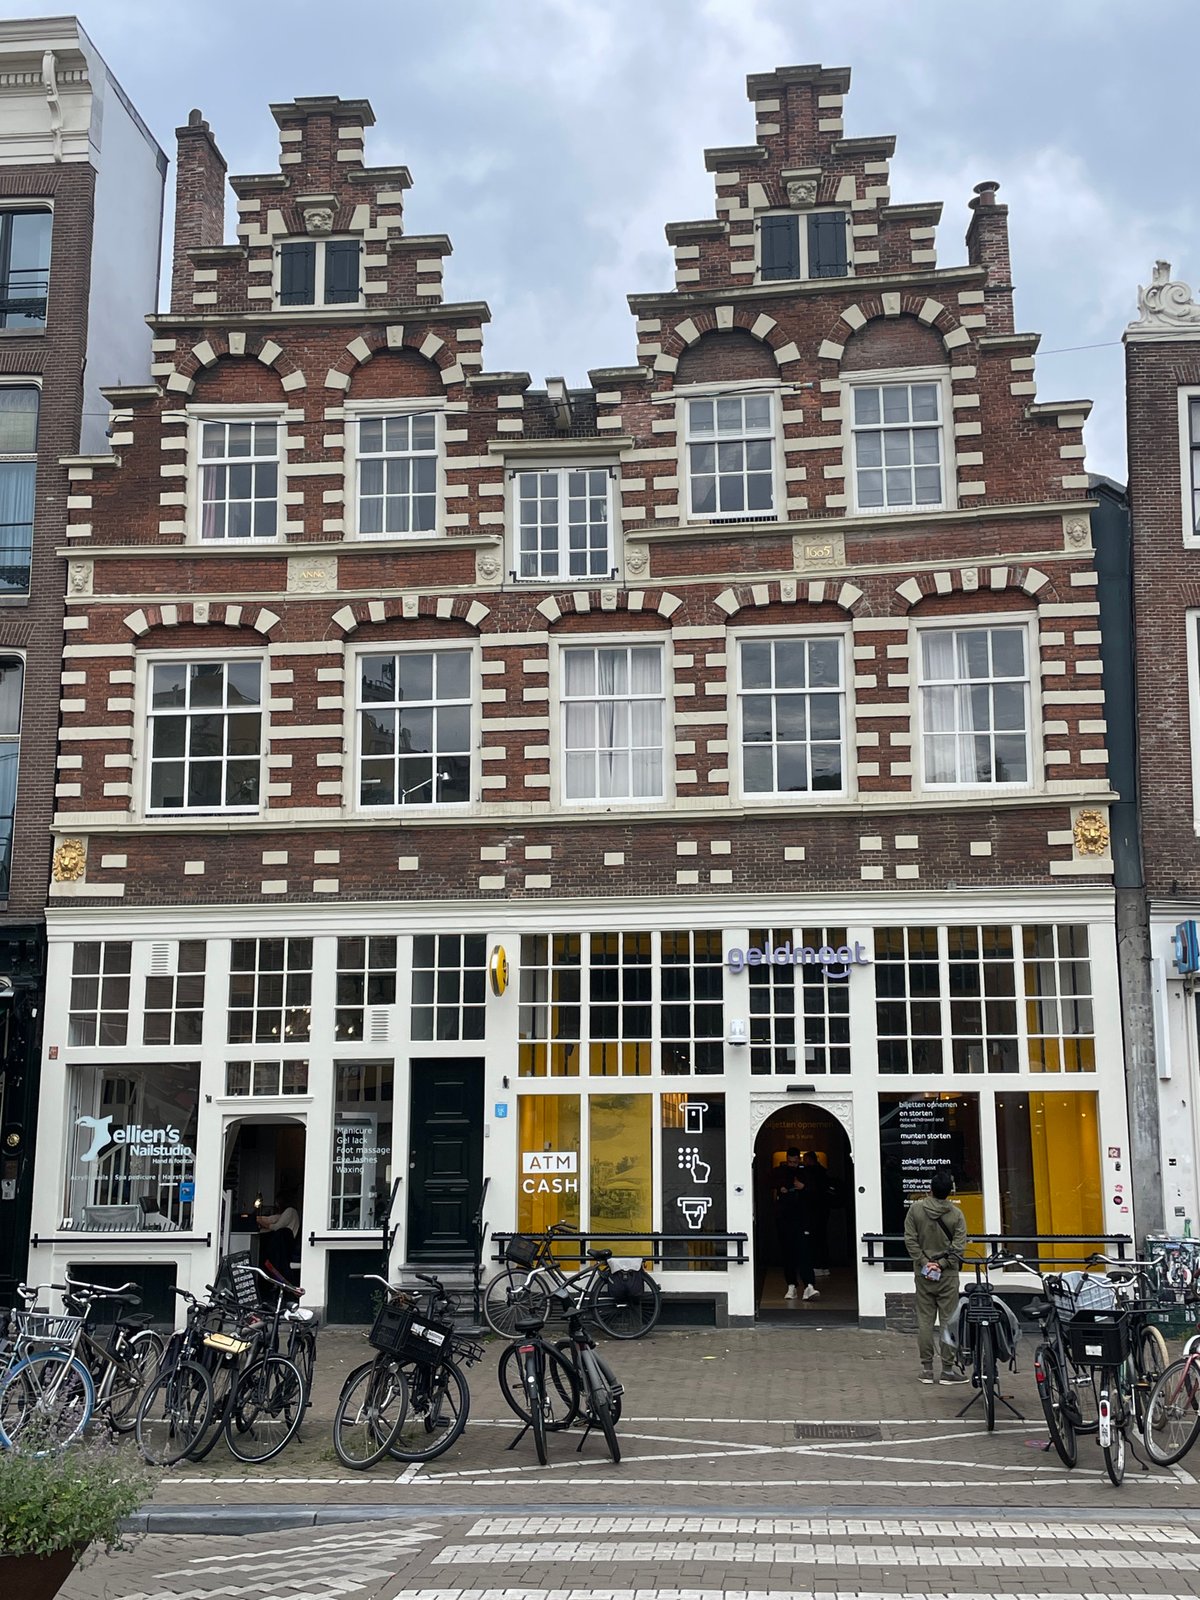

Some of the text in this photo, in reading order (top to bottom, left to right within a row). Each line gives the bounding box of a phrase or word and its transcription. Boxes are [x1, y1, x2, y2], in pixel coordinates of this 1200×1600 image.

[806, 545, 831, 558] 1605
[300, 570, 326, 579] ANNO
[728, 941, 868, 974] geldmaat
[336, 1136, 368, 1144] Gel lack
[129, 1143, 192, 1156] Nailstudio
[336, 1146, 391, 1156] Foot massage
[529, 1156, 571, 1170] ATM
[335, 1165, 364, 1175] Waxing
[114, 1173, 127, 1181] Spa
[522, 1178, 578, 1194] CASH
